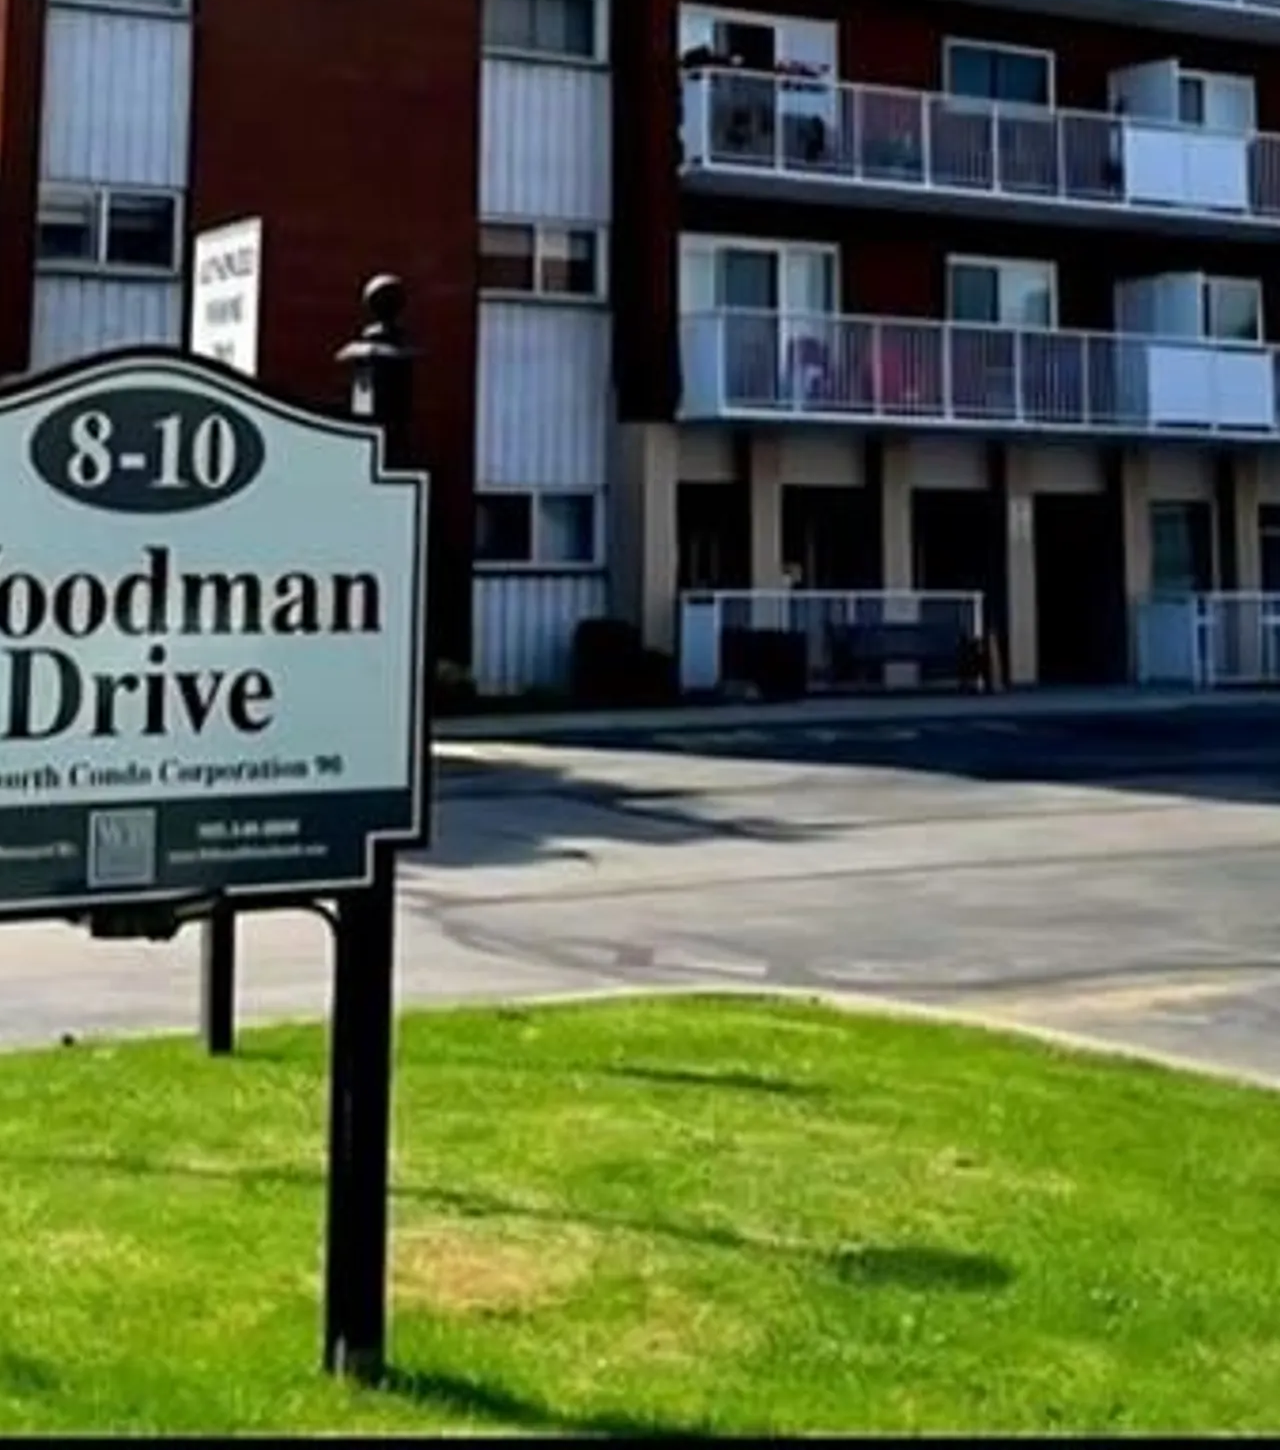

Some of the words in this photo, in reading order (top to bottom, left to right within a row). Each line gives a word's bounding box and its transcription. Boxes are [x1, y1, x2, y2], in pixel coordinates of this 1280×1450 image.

[67, 410, 237, 491] 8-10
[69, 761, 152, 789] Condo
[158, 756, 308, 788] Corporation
